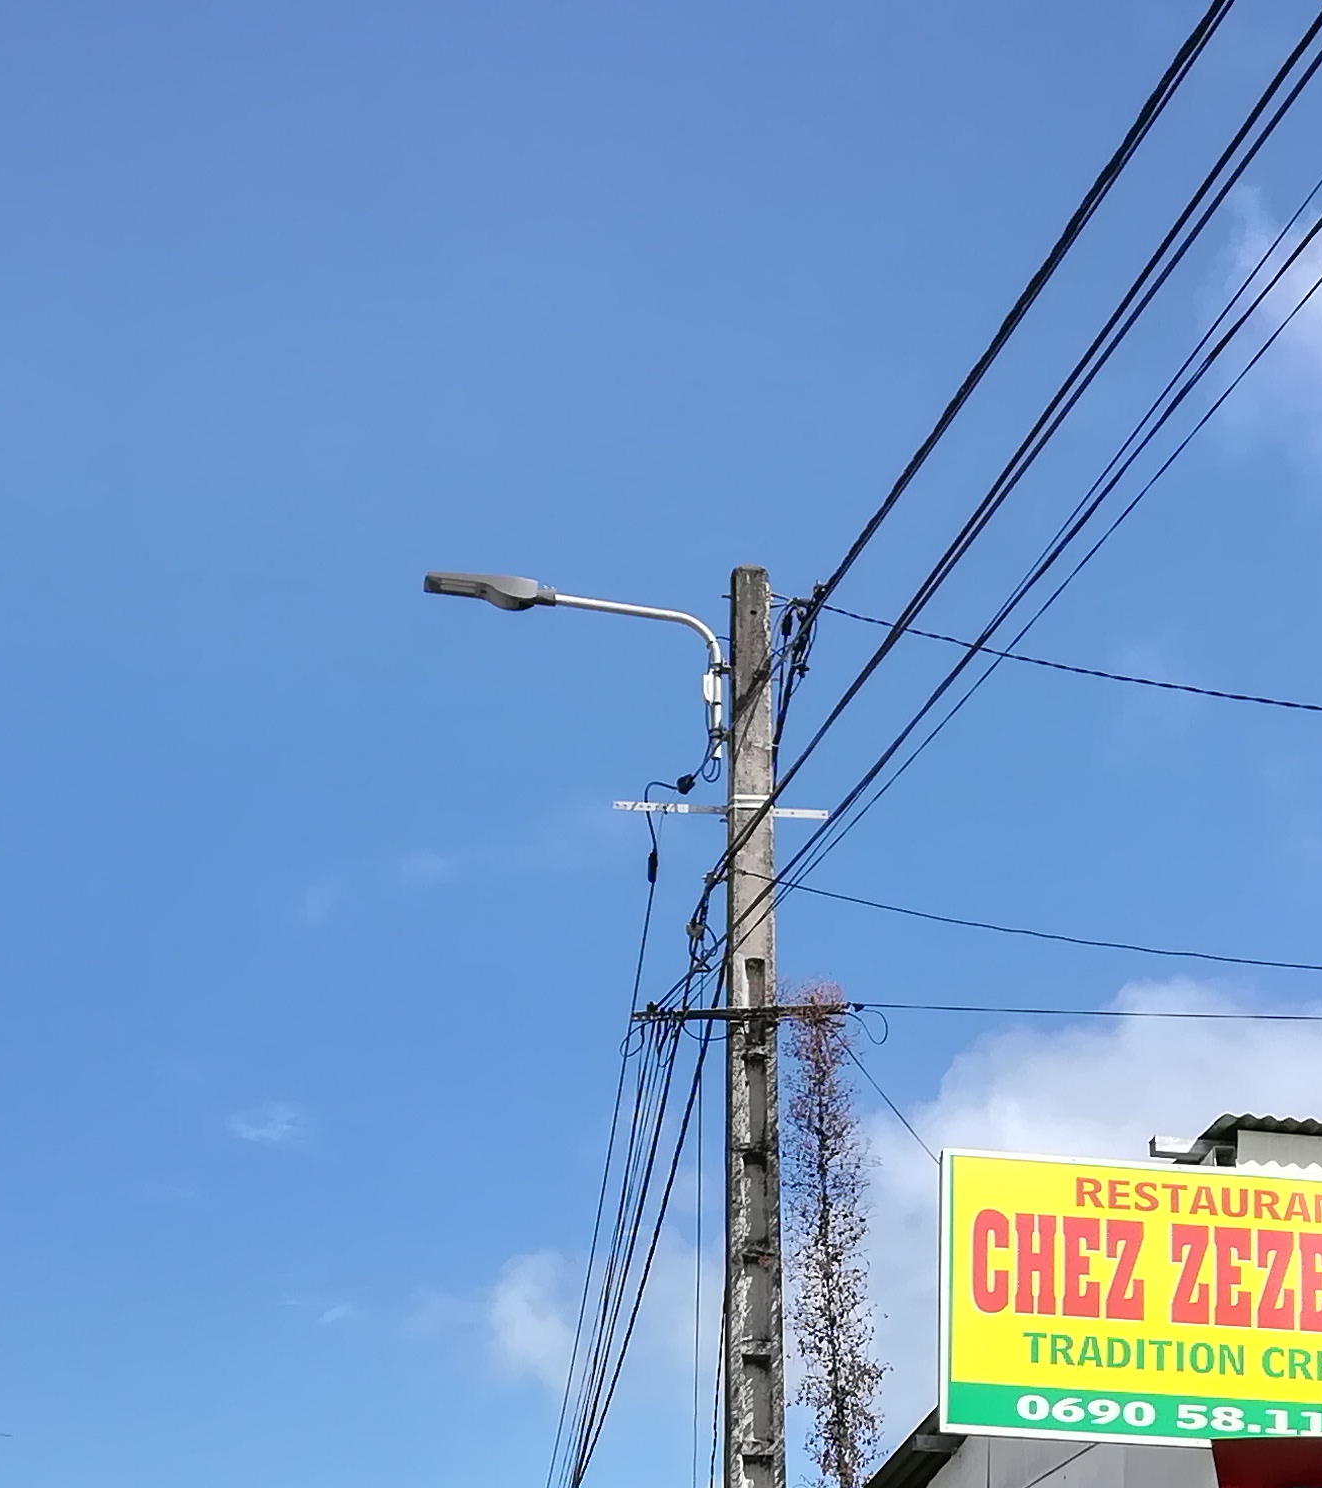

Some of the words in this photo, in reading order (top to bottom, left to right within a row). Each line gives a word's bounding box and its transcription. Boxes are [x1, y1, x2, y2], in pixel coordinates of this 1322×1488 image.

[973, 1209, 1145, 1322] CHEZ
[1022, 1331, 1245, 1375] TRADITION
[1016, 1394, 1157, 1429] 0690
